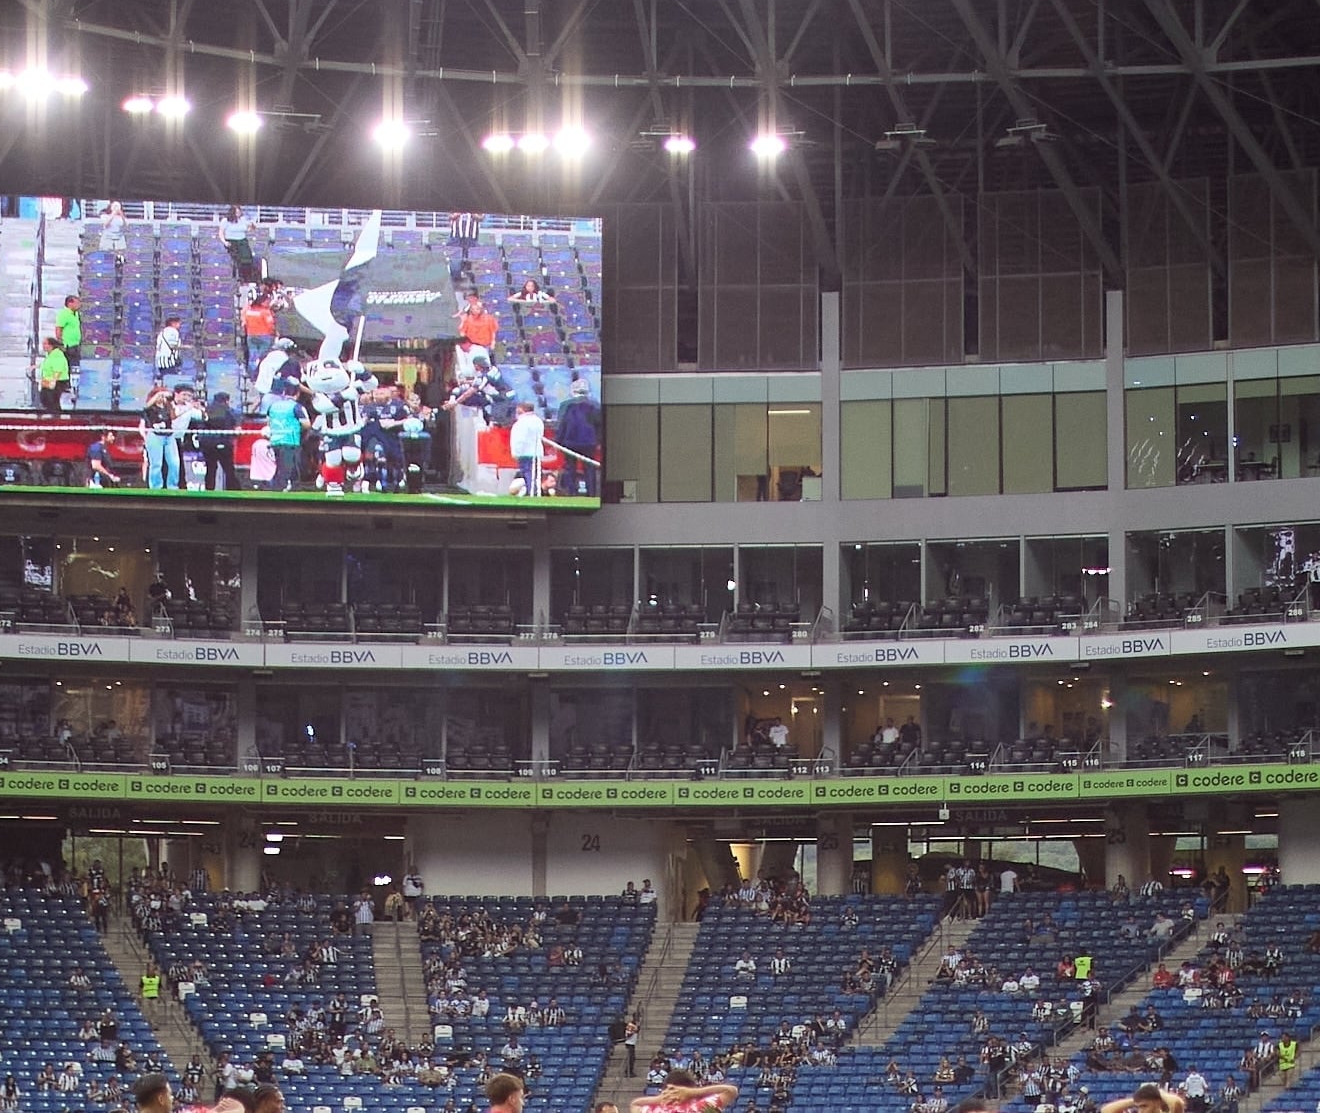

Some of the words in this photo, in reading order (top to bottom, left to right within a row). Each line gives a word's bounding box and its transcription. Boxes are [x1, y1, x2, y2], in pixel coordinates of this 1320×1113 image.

[1206, 637, 1243, 649] Estadio
[1244, 631, 1286, 646] BBVA
[17, 643, 57, 656] Estadio
[58, 642, 102, 656] BBVA
[156, 648, 194, 661] Estadio
[196, 647, 240, 661] BBVA
[969, 647, 1009, 659] Estadio
[1009, 644, 1053, 658] BBVA
[1085, 643, 1122, 656] Estadio
[1122, 639, 1164, 654] BBVA
[290, 651, 330, 664] Estadio
[331, 650, 375, 664] BBVA
[428, 653, 467, 665] Estadio
[468, 651, 513, 664] BBVA
[564, 654, 601, 666] Estadio
[602, 653, 648, 665] BBVA
[700, 654, 738, 666] Estadio
[739, 651, 784, 665] BBVA
[837, 650, 874, 663] Estadio
[875, 648, 919, 661] BBVA
[1135, 777, 1168, 787] codere
[1192, 773, 1244, 788] codere
[1266, 770, 1318, 784] codere
[8, 778, 55, 791] codere
[72, 780, 119, 792] codere
[146, 782, 191, 795] codere
[210, 783, 256, 796] codere
[281, 785, 327, 797] codere
[893, 783, 937, 795] codere
[965, 782, 1009, 794] codere
[1029, 780, 1073, 792] codere
[1091, 780, 1124, 789] codere
[347, 786, 392, 798] codere
[420, 787, 466, 799] codere
[485, 788, 531, 800] codere
[557, 788, 602, 800] codere
[622, 788, 667, 799] codere
[693, 788, 739, 799] codere
[758, 787, 803, 799] codere
[830, 786, 874, 797] codere
[582, 834, 600, 851] 24
